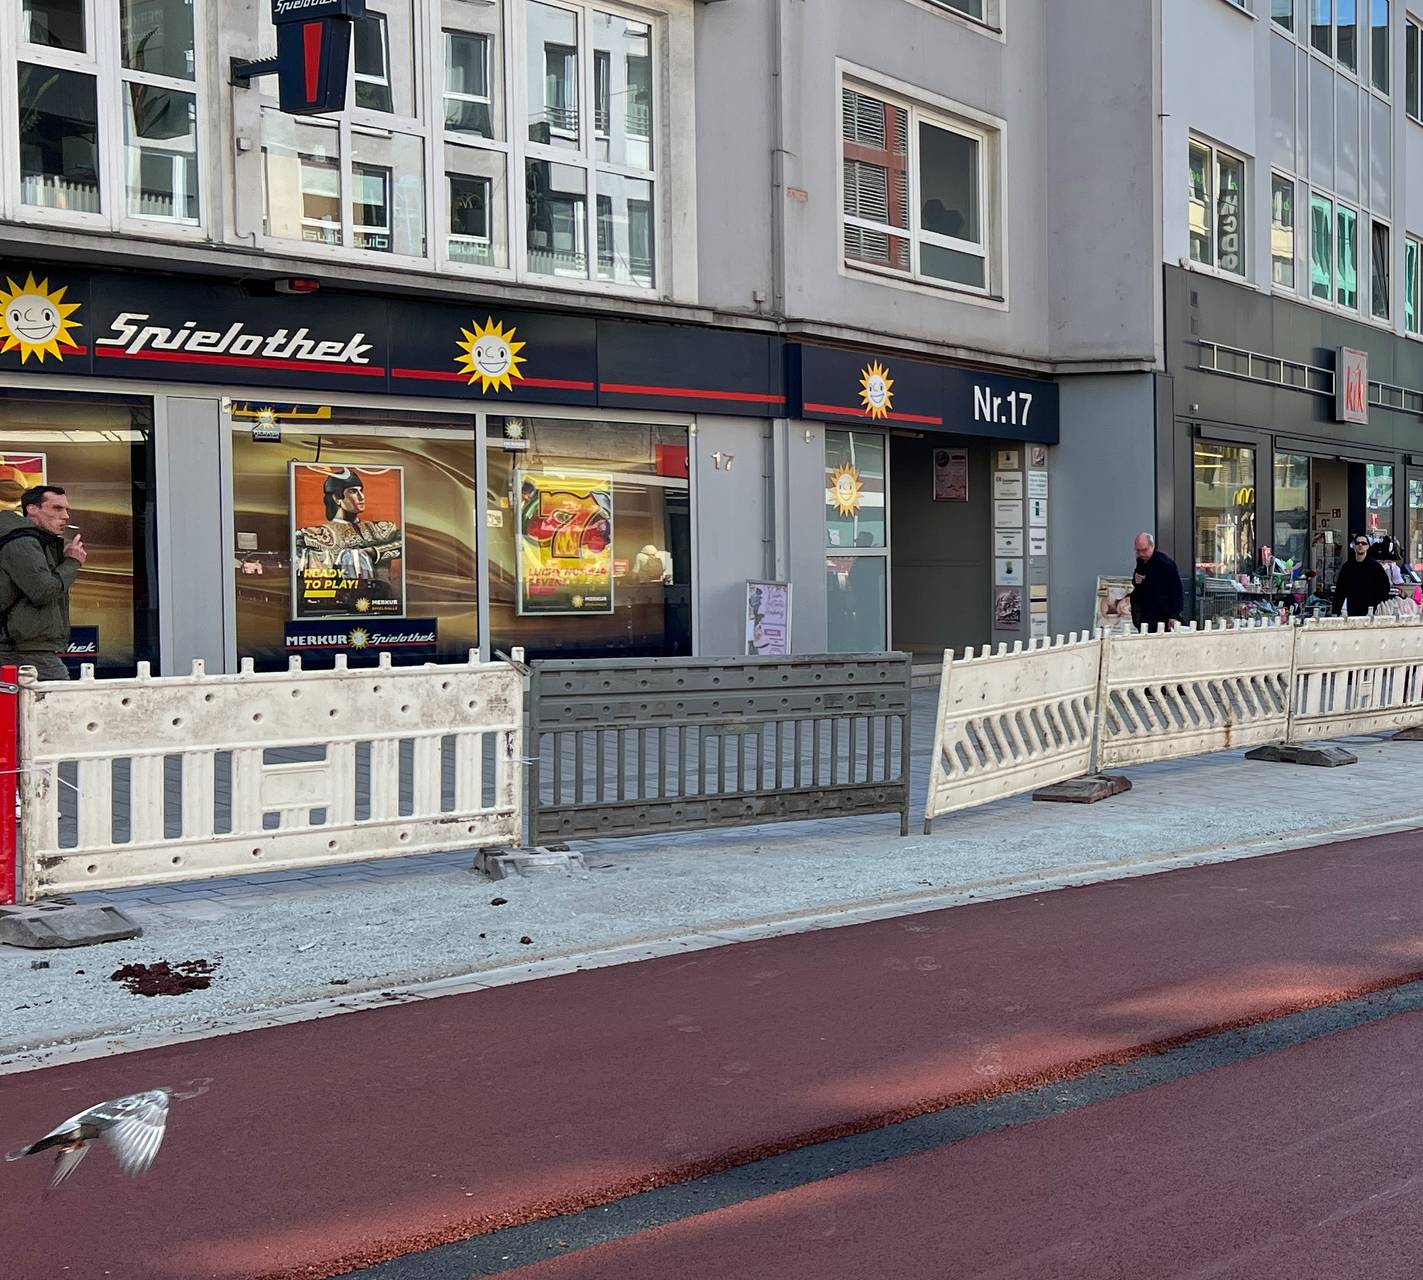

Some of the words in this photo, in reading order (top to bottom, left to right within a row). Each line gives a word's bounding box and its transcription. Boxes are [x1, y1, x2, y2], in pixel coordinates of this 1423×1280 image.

[95, 312, 374, 364] Spielothek
[974, 385, 1033, 426] Nr.17
[711, 451, 735, 471] 17
[303, 568, 346, 578] READY
[304, 580, 322, 589] TO
[324, 579, 360, 589] PLAY!
[286, 635, 348, 646] MERKUR
[368, 632, 436, 645] Spielothek
